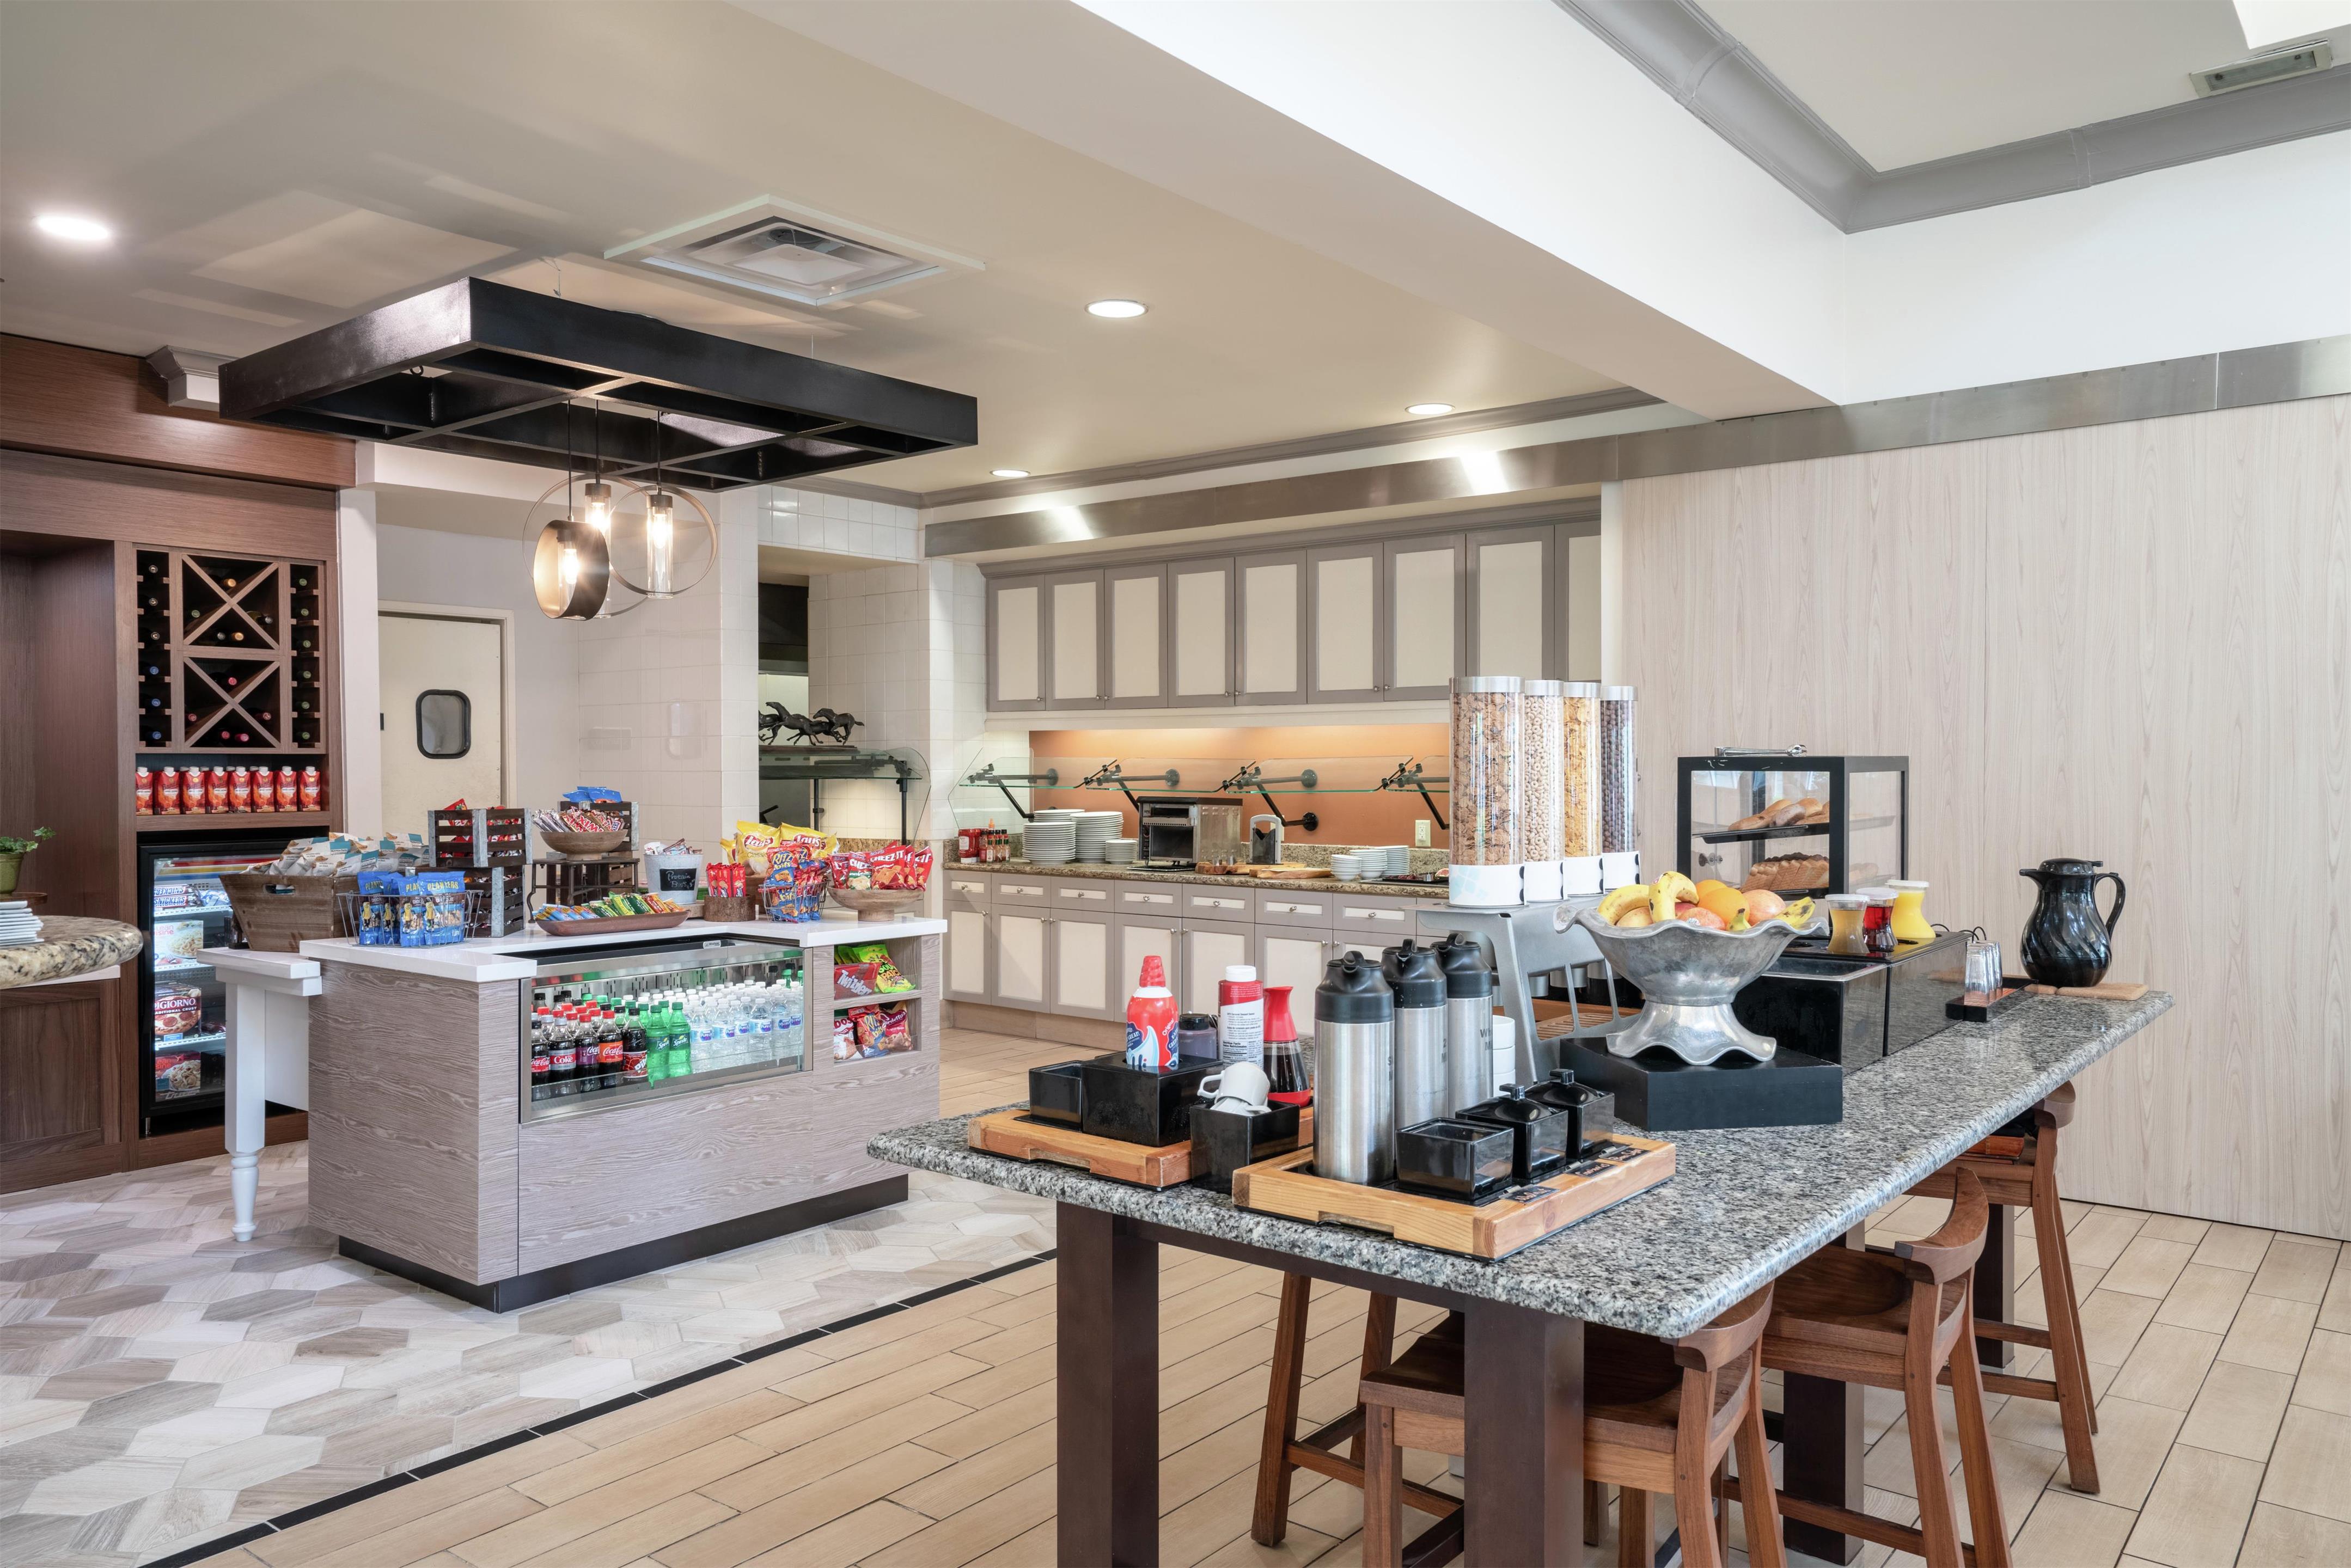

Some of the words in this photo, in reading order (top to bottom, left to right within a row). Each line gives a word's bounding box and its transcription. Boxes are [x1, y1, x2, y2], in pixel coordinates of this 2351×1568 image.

[773, 854, 793, 865] RITZ
[427, 881, 459, 891] PLANTERS
[673, 1037, 687, 1046] Sprite
[554, 1056, 573, 1064] Coke
